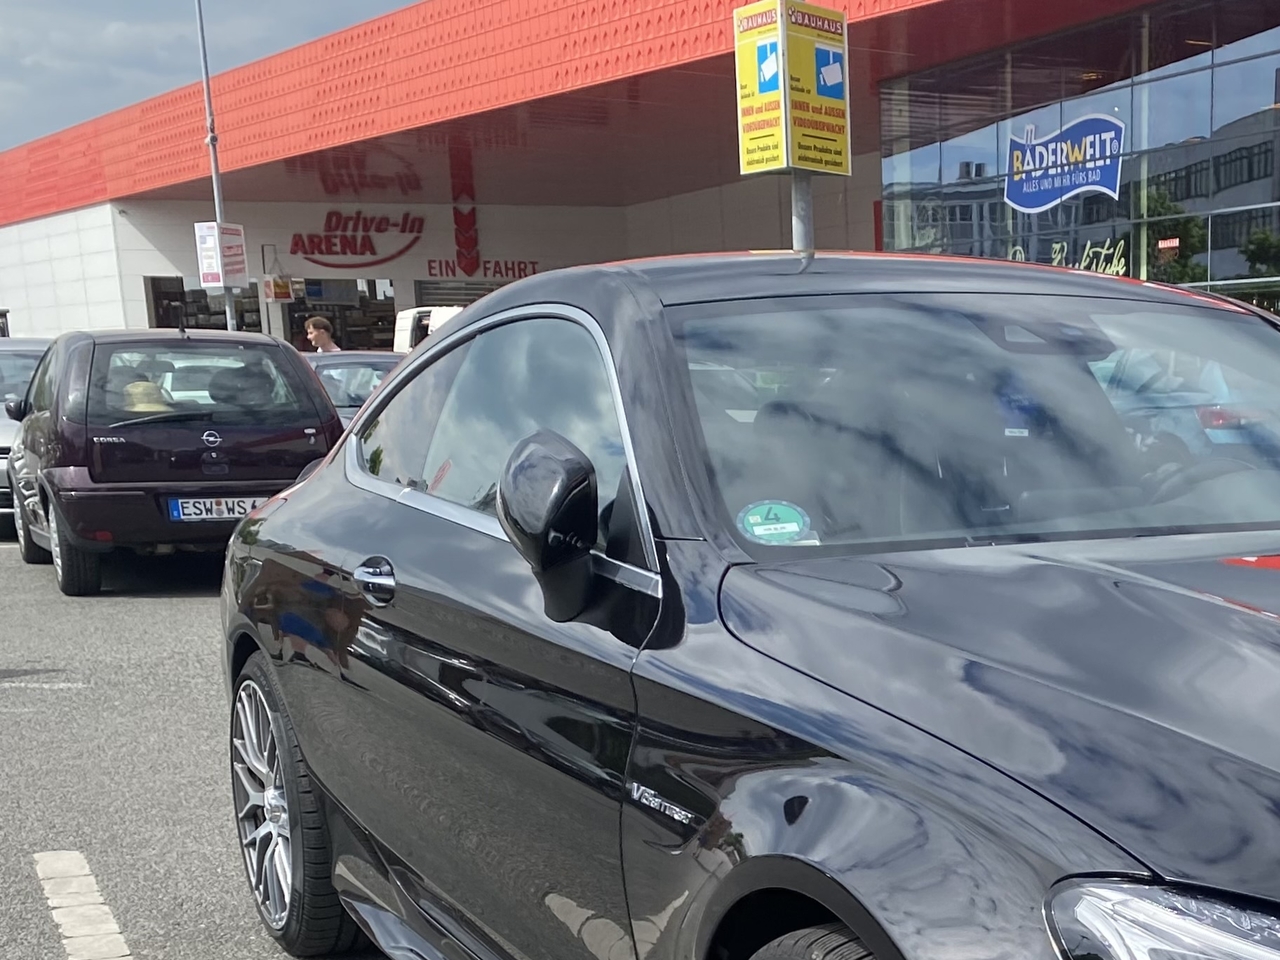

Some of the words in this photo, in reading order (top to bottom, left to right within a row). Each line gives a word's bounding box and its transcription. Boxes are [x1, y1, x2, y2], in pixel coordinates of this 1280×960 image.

[742, 10, 777, 30] BAUHAUS
[796, 12, 842, 33] BAUHAUS
[1022, 180, 1039, 193] ALLES
[1040, 177, 1053, 190] UND
[1071, 172, 1087, 185] FÜRS
[1088, 169, 1101, 183] BAD
[323, 210, 425, 234] Drive-In
[290, 233, 377, 256] ARENA
[427, 259, 456, 278] EIN
[482, 260, 539, 279] FAHRT
[180, 500, 214, 517] ESW
[225, 500, 247, 515] WS
[764, 506, 782, 522] 4
